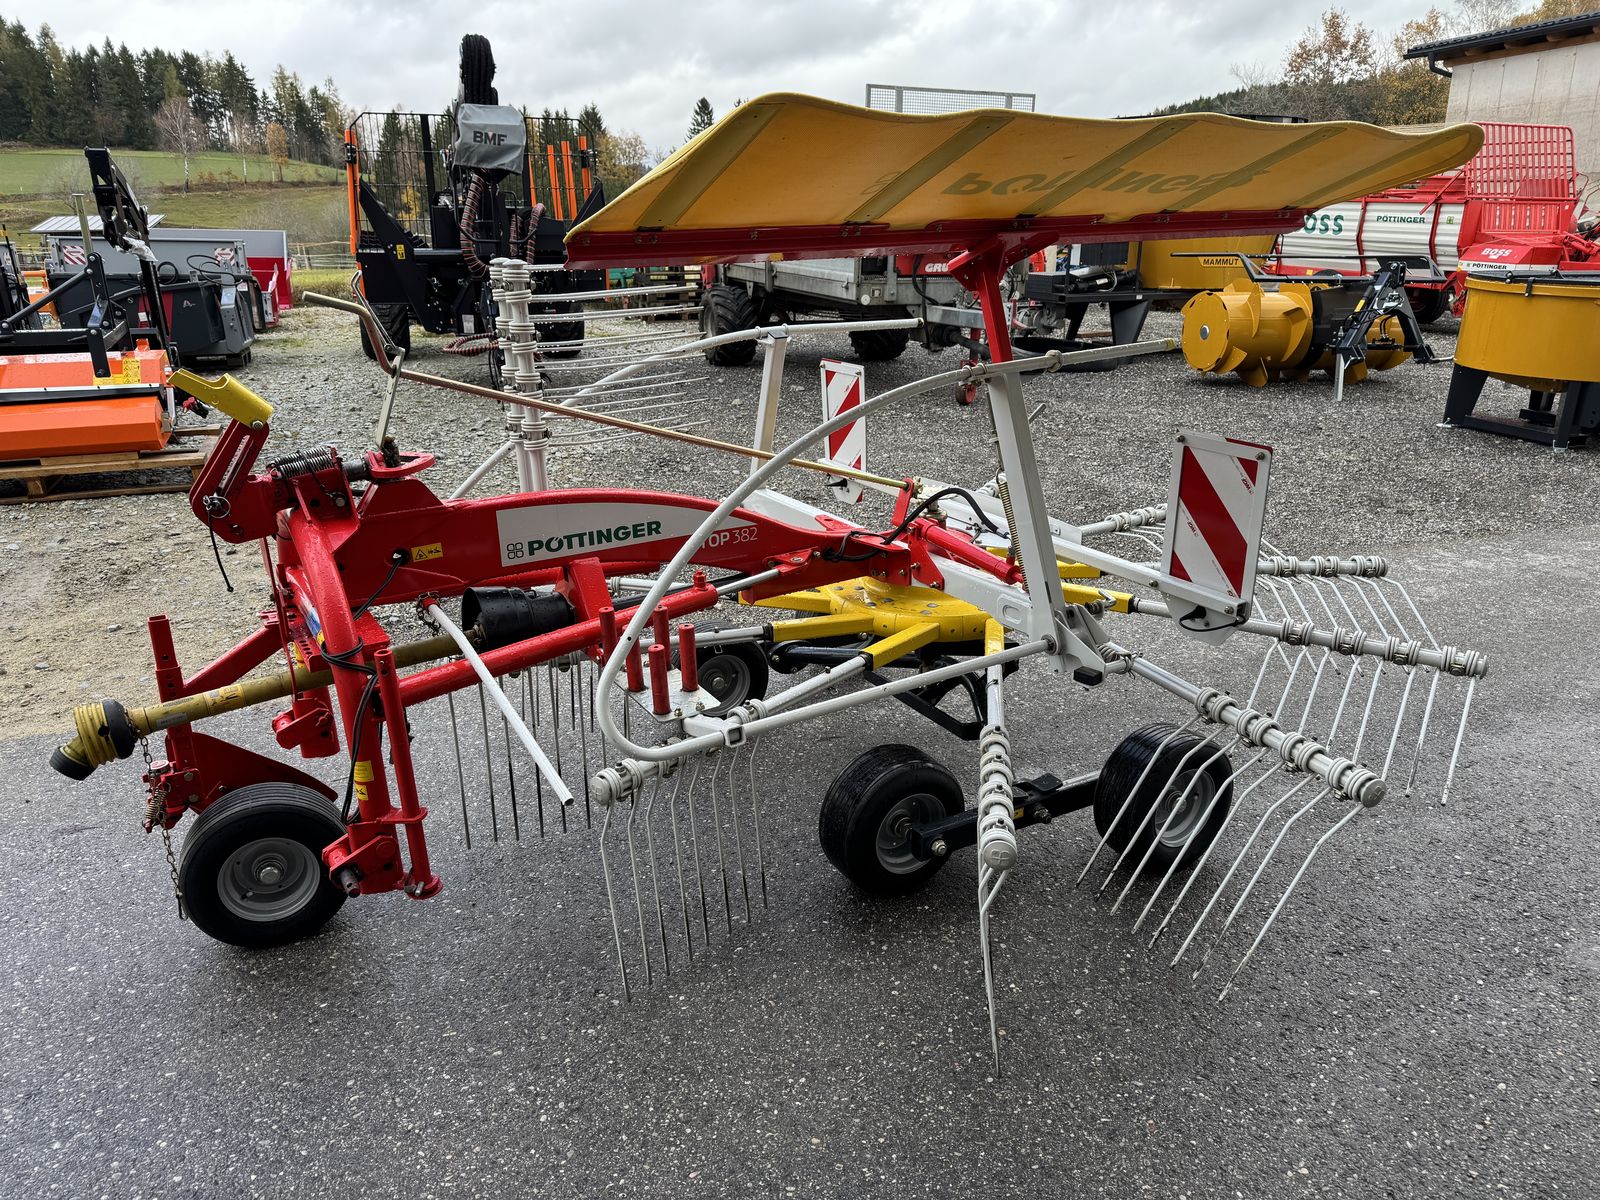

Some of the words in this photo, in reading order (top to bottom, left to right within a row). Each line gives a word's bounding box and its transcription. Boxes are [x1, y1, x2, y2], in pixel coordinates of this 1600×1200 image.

[472, 130, 508, 146] BMF
[1303, 214, 1345, 235] OSS
[1481, 248, 1512, 257] BOSS
[925, 263, 949, 273] GRU
[1203, 258, 1239, 266] MAMMUT
[527, 520, 662, 556] PÖTTINGER
[732, 526, 758, 544] 382
